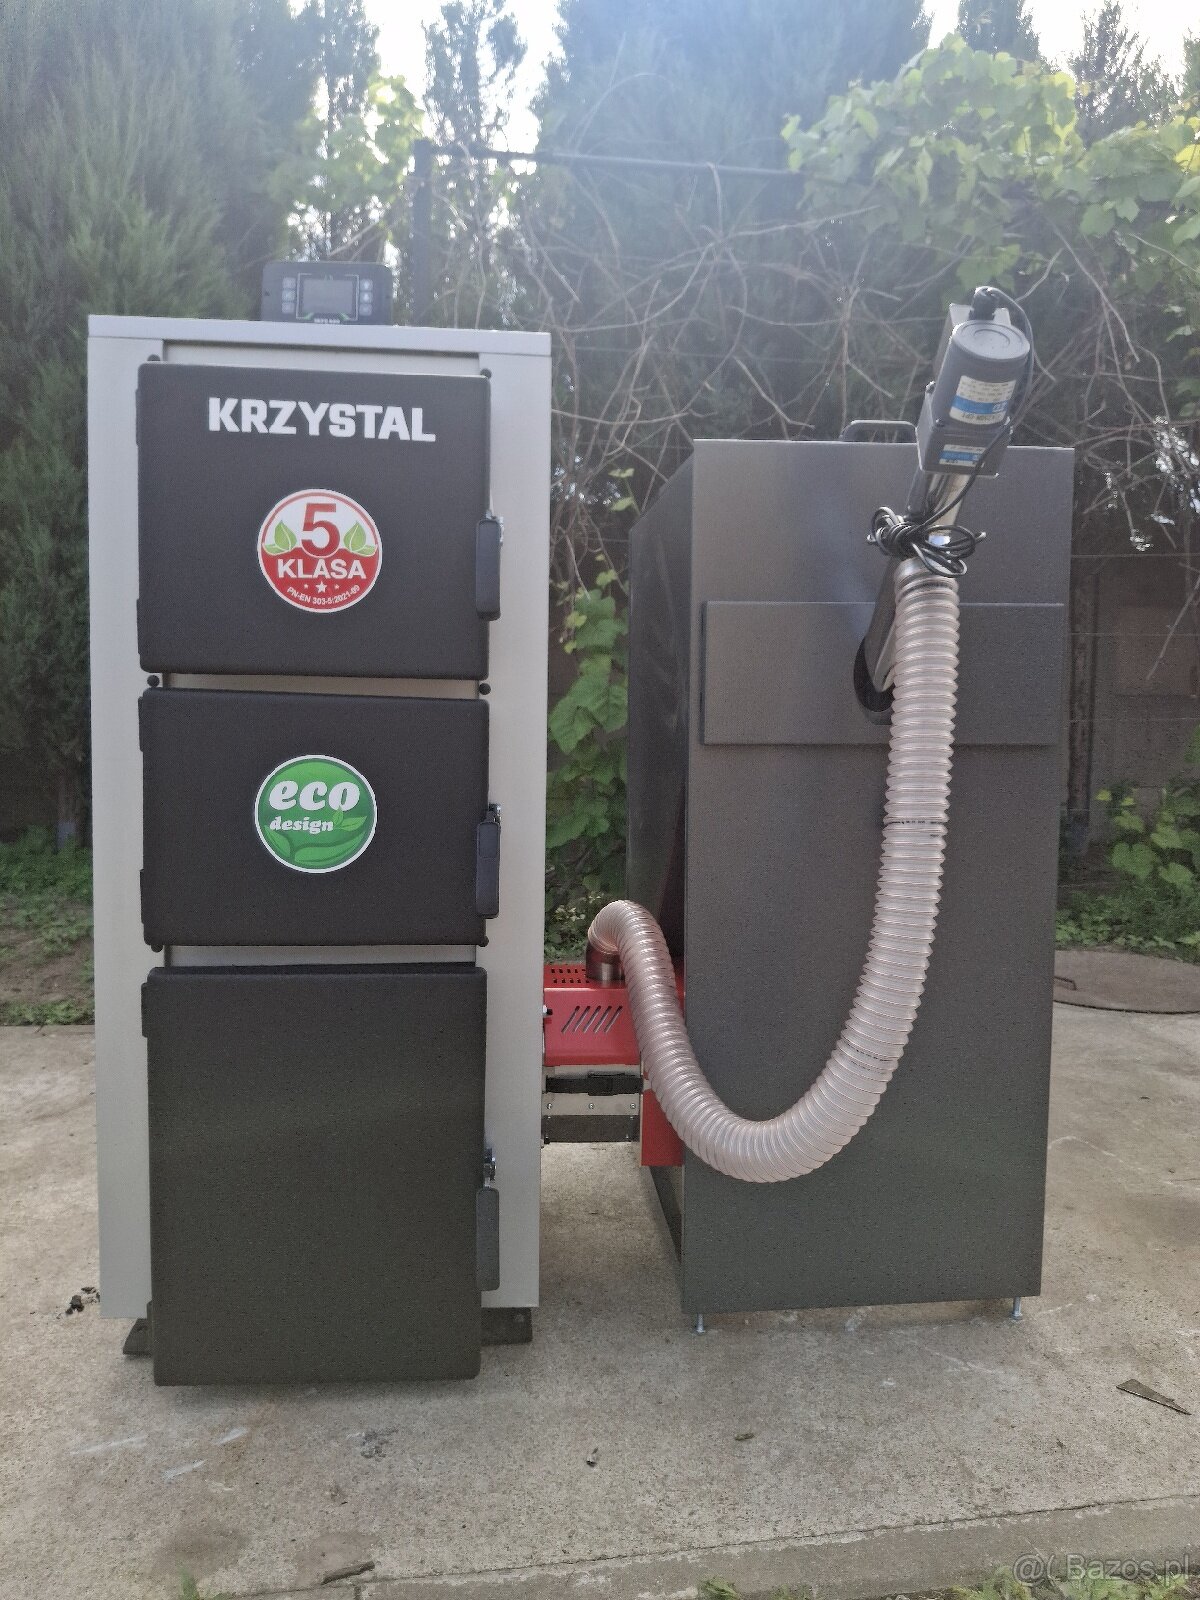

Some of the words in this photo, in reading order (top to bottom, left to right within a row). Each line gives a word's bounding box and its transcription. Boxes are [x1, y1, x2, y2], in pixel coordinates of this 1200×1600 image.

[208, 396, 437, 443] KRZYSTAL
[301, 503, 341, 557] 5
[277, 558, 367, 579] KLASA
[286, 586, 312, 604] PN-EN
[268, 780, 361, 812] eco
[269, 815, 334, 835] design
